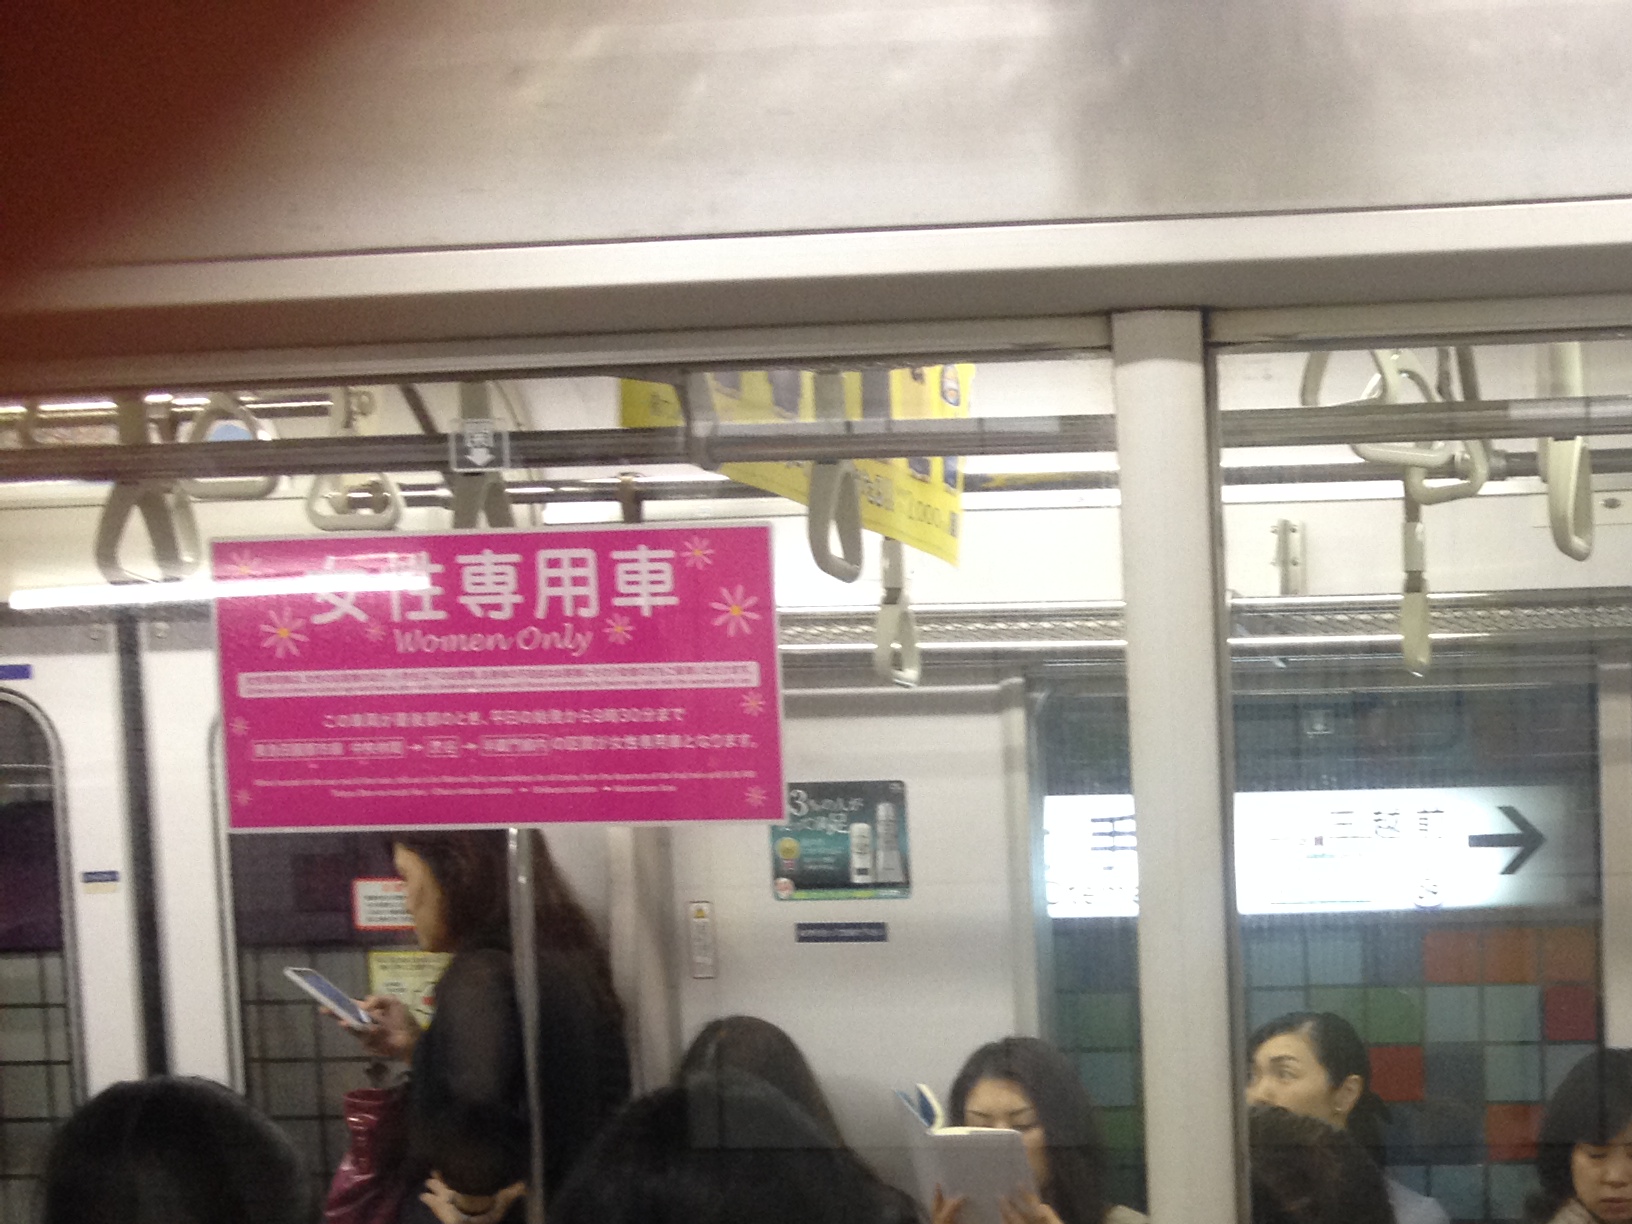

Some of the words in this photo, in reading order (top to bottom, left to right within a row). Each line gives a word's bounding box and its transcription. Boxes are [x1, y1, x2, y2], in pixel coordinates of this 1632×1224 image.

[311, 545, 680, 624] 女性専用車
[394, 629, 513, 653] Women
[516, 622, 594, 657] Only
